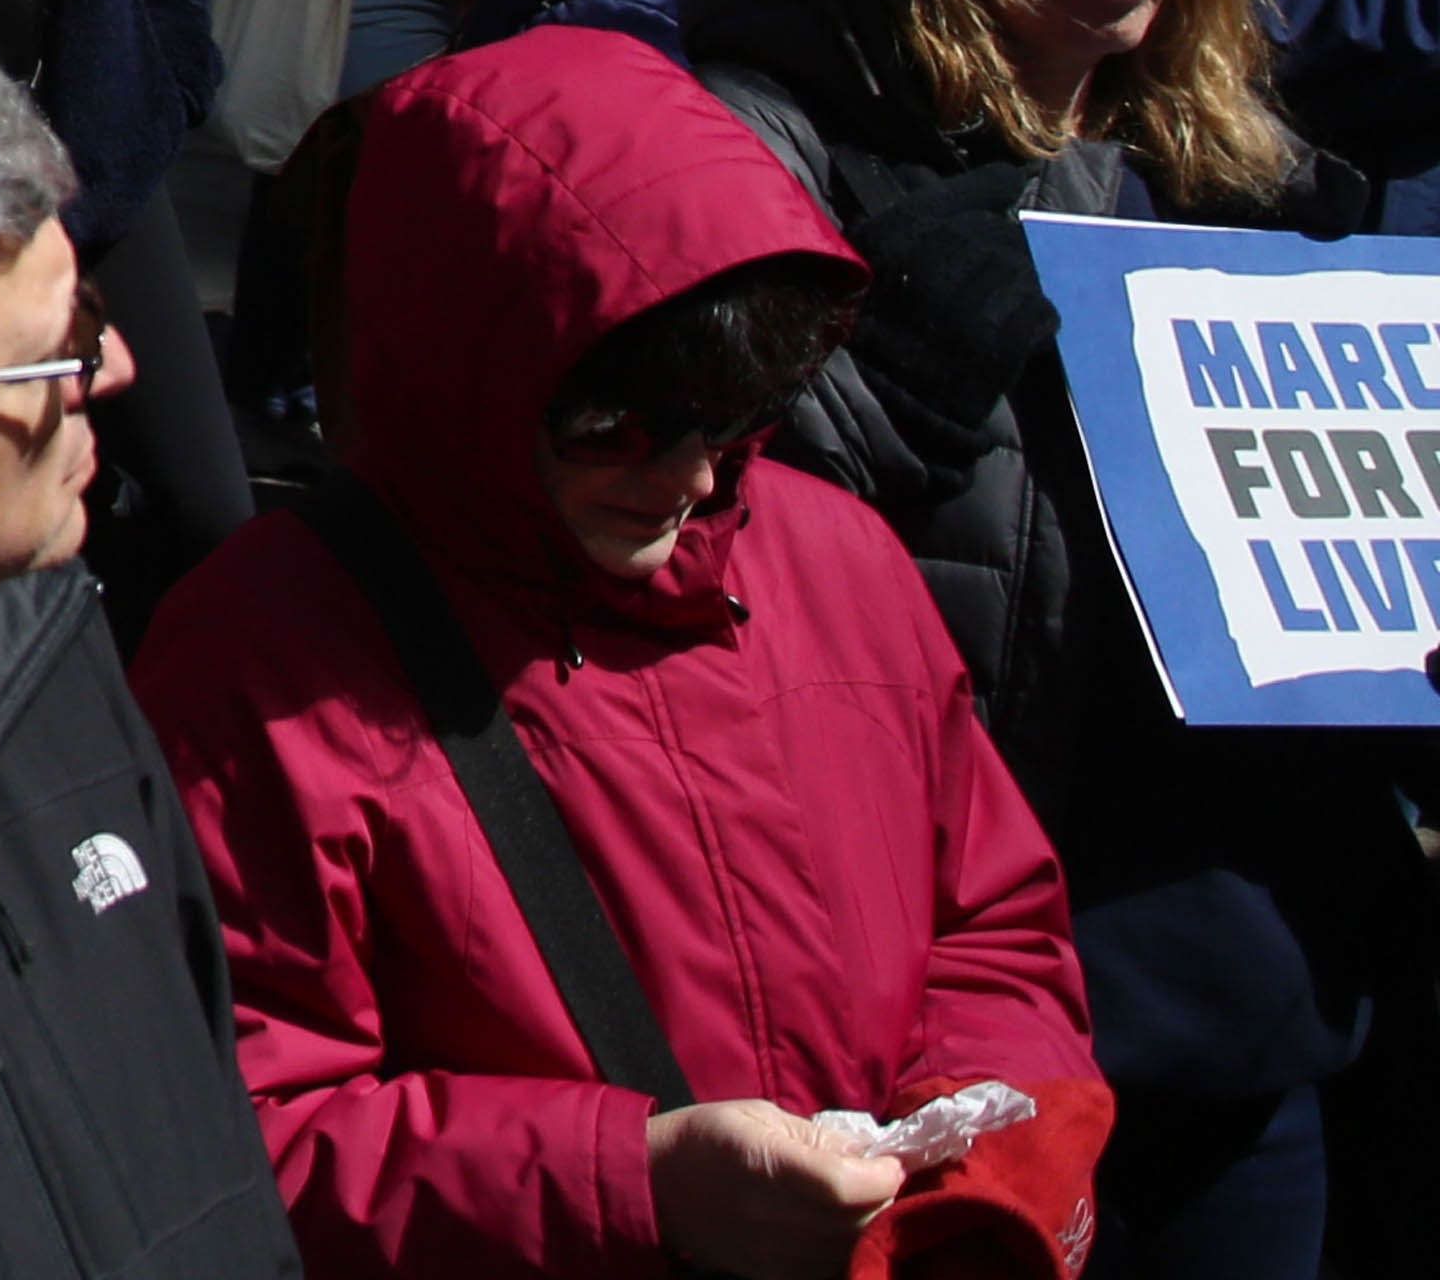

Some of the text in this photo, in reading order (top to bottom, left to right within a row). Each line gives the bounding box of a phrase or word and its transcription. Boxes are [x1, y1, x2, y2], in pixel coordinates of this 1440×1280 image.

[1169, 318, 1440, 410] MARC
[1204, 427, 1422, 520] FOR
[1246, 538, 1440, 634] LIVE
